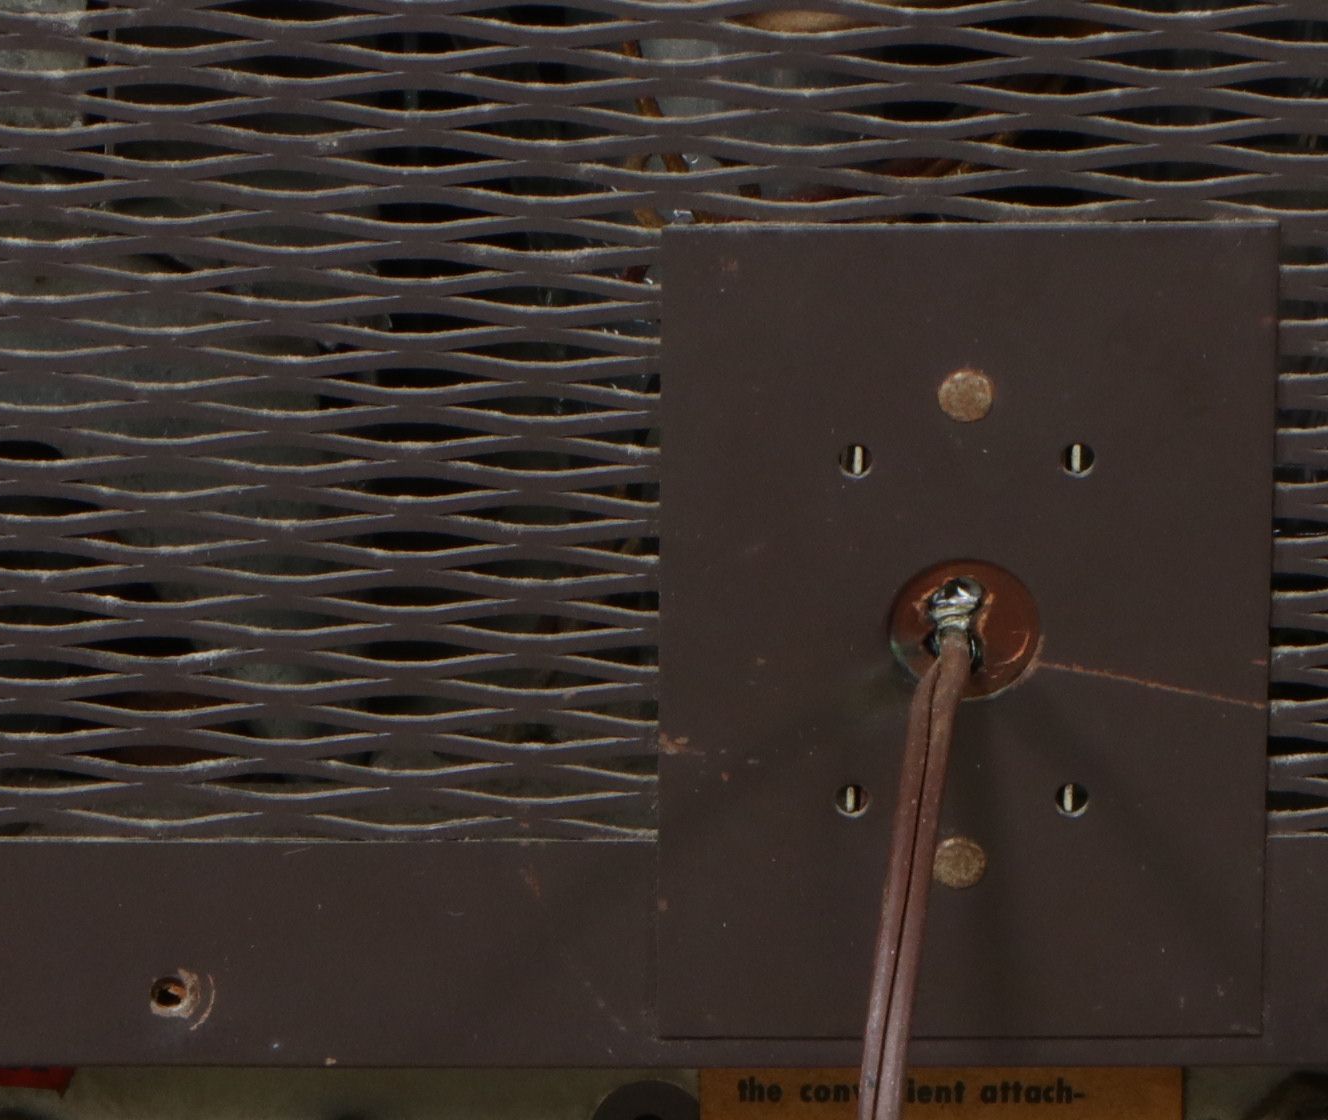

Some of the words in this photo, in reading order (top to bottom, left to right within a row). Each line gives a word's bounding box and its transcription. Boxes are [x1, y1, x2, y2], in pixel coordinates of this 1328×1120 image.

[737, 1076, 784, 1103] the
[799, 1077, 967, 1104] conient
[979, 1076, 1087, 1104] attach-
